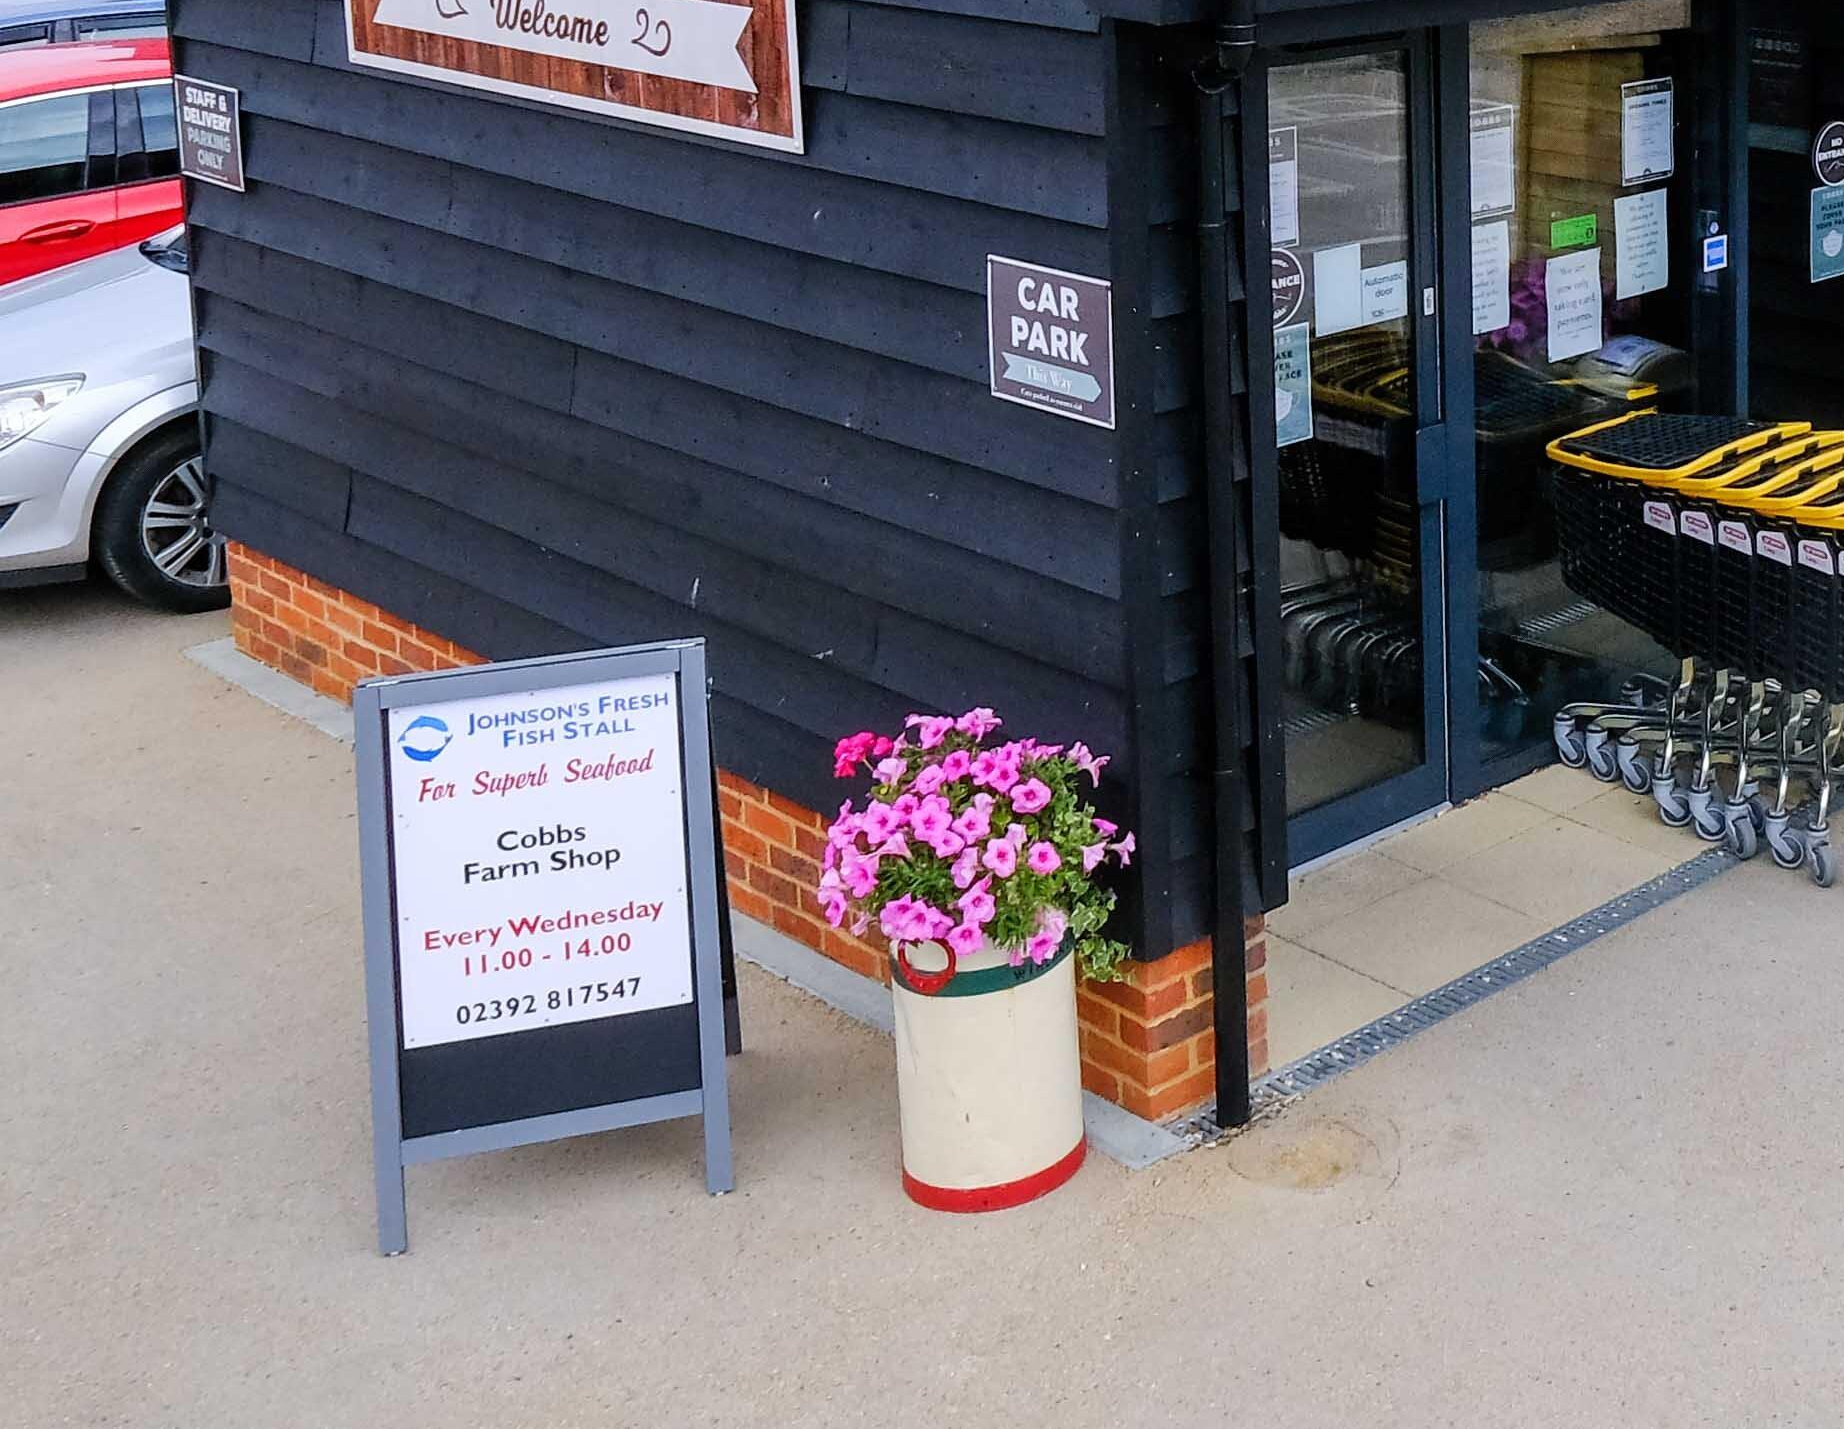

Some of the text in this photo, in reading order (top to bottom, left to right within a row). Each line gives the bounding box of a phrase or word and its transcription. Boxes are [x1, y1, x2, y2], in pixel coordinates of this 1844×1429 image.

[185, 86, 217, 109] STAFF
[183, 106, 232, 133] DELIVERY
[187, 127, 231, 153] PARKING
[1831, 137, 1844, 147] NO
[198, 149, 224, 171] ONLY
[1018, 277, 1080, 321] CAR
[1272, 274, 1300, 289] ANCE
[1011, 315, 1089, 366] PARK
[468, 692, 669, 735] JOHNSON'S FRESH
[503, 718, 635, 749] FISH STALL
[418, 749, 655, 803] For Superb Seafood
[496, 824, 587, 852] Cobbs
[463, 845, 621, 885] Farm Shop
[424, 900, 664, 951] Every Wednesday
[464, 947, 532, 977] 11.00
[563, 932, 632, 962] 14.00
[456, 977, 642, 1025] 02392 817547
